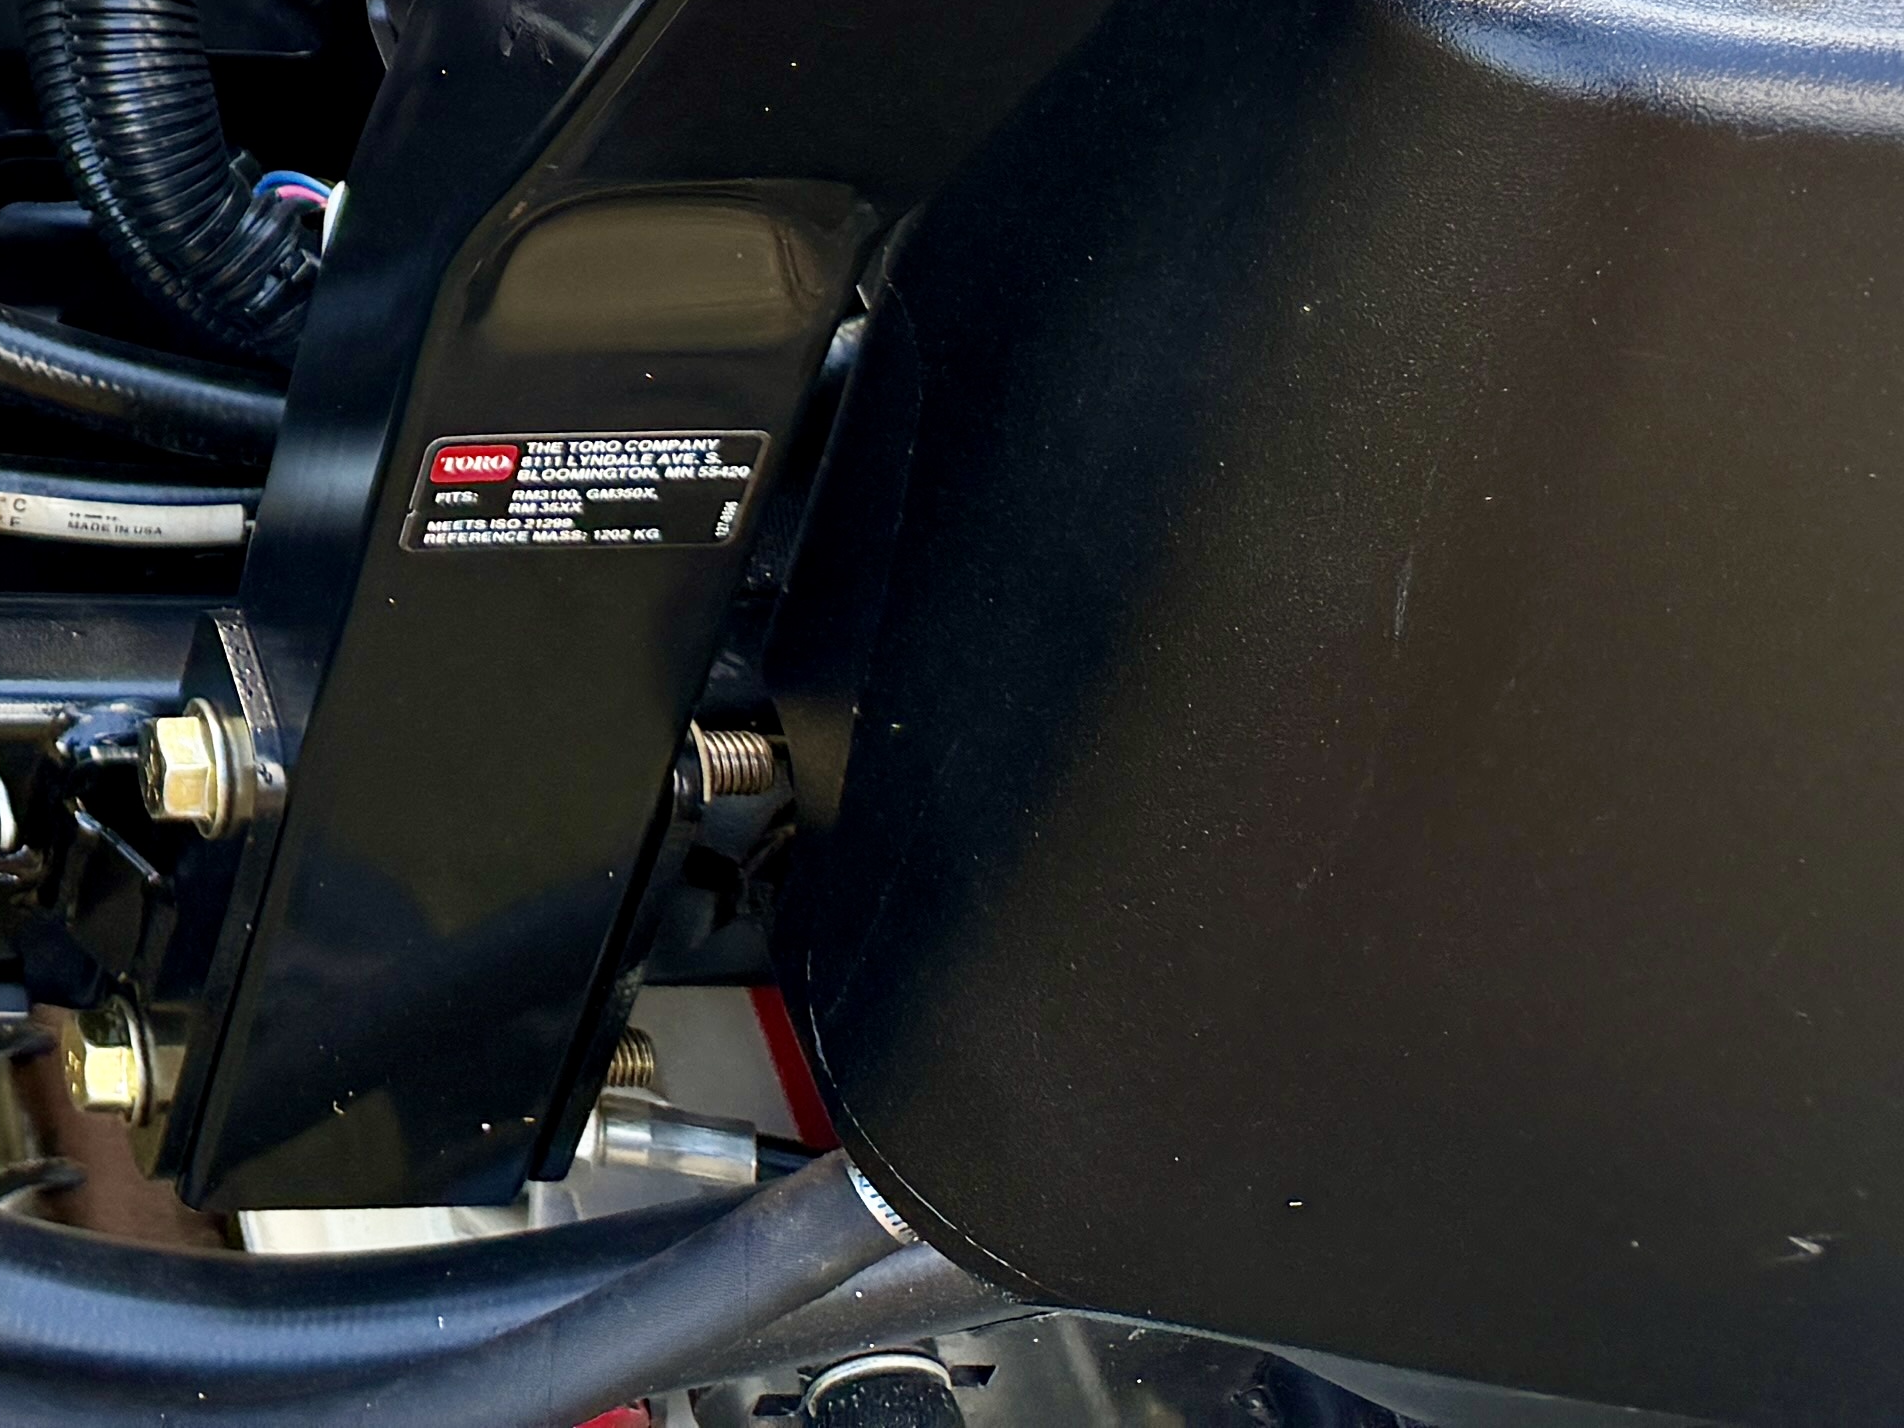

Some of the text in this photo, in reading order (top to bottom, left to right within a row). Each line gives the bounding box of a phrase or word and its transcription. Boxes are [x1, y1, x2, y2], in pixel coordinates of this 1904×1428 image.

[527, 438, 720, 453] THE TORO COMPANY
[440, 454, 511, 472] TORO
[520, 452, 723, 468] 8111 LYNDALE AVE. S.
[517, 465, 752, 482] BLOOMINGTON, MN 55420
[435, 491, 479, 505] FITS:
[508, 503, 536, 515] RM
[67, 520, 110, 533] MADE
[427, 519, 487, 531] MEETS
[490, 518, 521, 530] ISO
[423, 531, 530, 544] REFERENCE
[532, 530, 588, 543] MASS:
[633, 528, 662, 542] KG
